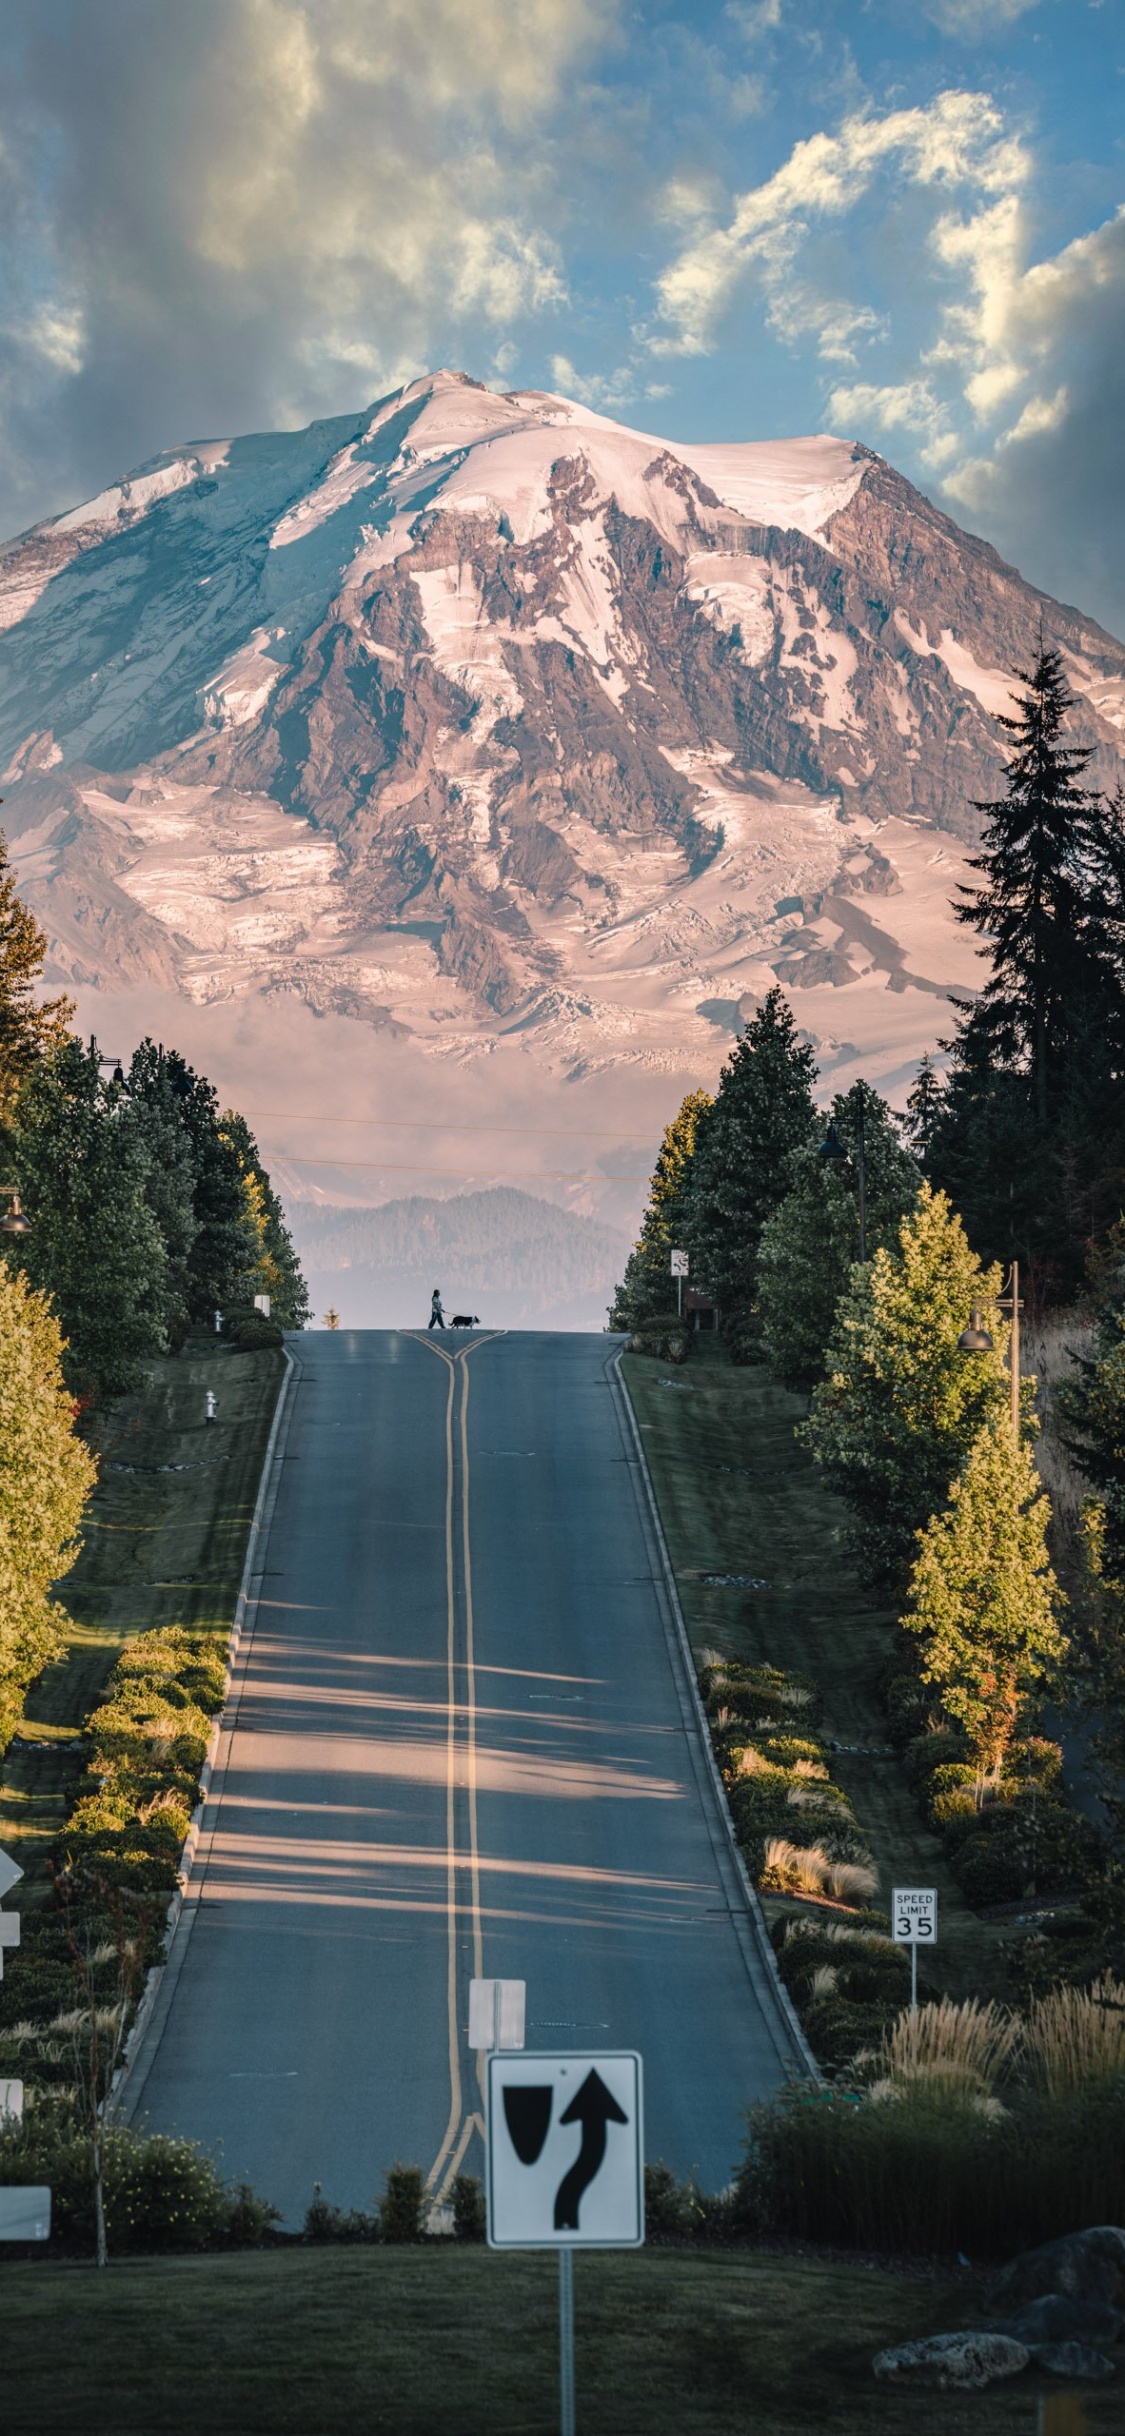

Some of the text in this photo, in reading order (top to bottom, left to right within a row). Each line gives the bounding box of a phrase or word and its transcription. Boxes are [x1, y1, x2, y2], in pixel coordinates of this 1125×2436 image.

[897, 1895, 932, 1904] SPEED
[900, 1906, 928, 1915] LIMIT
[897, 1917, 932, 1936] 35
